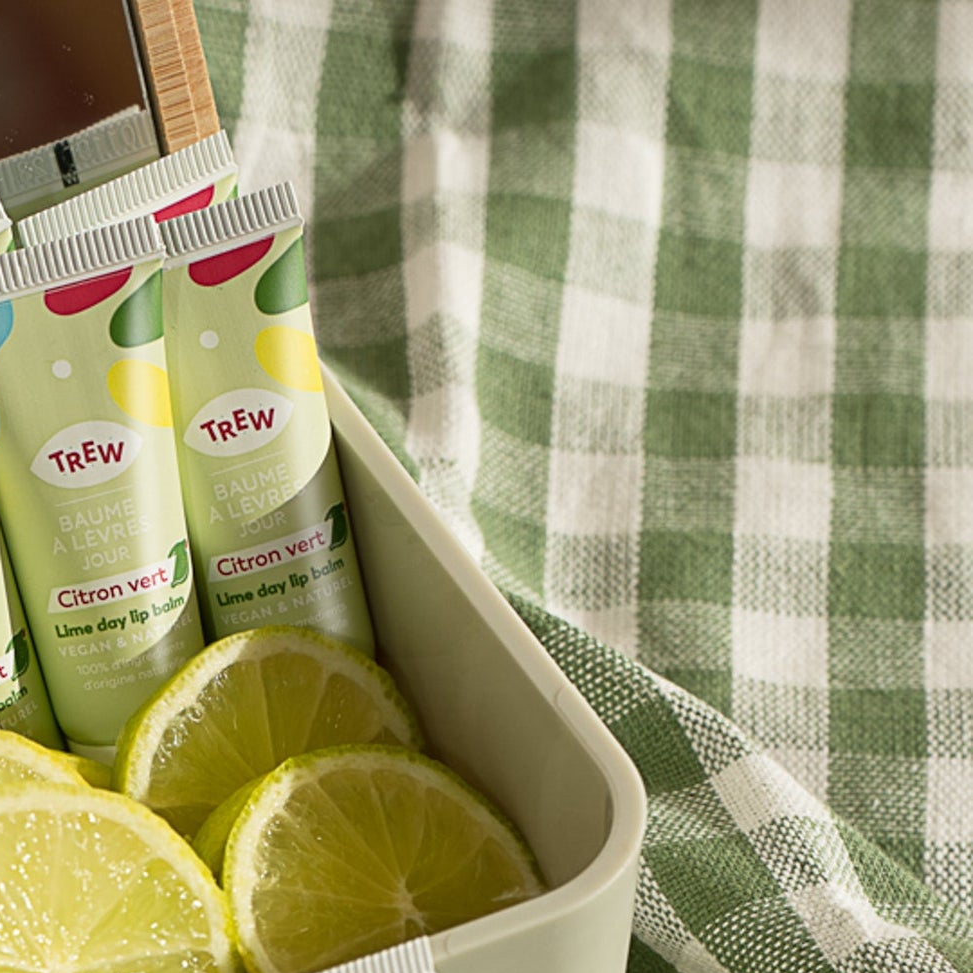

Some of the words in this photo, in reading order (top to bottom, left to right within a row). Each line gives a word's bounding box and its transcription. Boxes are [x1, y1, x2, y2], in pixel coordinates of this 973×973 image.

[200, 407, 275, 443] TREW
[48, 440, 125, 474] TREW
[213, 463, 289, 501] BAUME
[58, 498, 135, 533] BAUME
[239, 510, 287, 538] JOUR
[82, 545, 131, 571] JOUR
[217, 549, 282, 576] Citron
[285, 530, 325, 557] vert
[57, 584, 124, 608] Citron
[127, 567, 169, 593] vert
[216, 591, 254, 607] Lime
[257, 581, 287, 598] day
[288, 573, 309, 588] lip
[310, 558, 345, 581] balm
[55, 624, 93, 638] Lime
[97, 616, 127, 632] day
[129, 609, 150, 624] lip
[152, 596, 185, 617] balm
[221, 607, 273, 624] VEGAN
[277, 602, 288, 614] &
[58, 641, 112, 657] VEGAN
[116, 637, 127, 649] &
